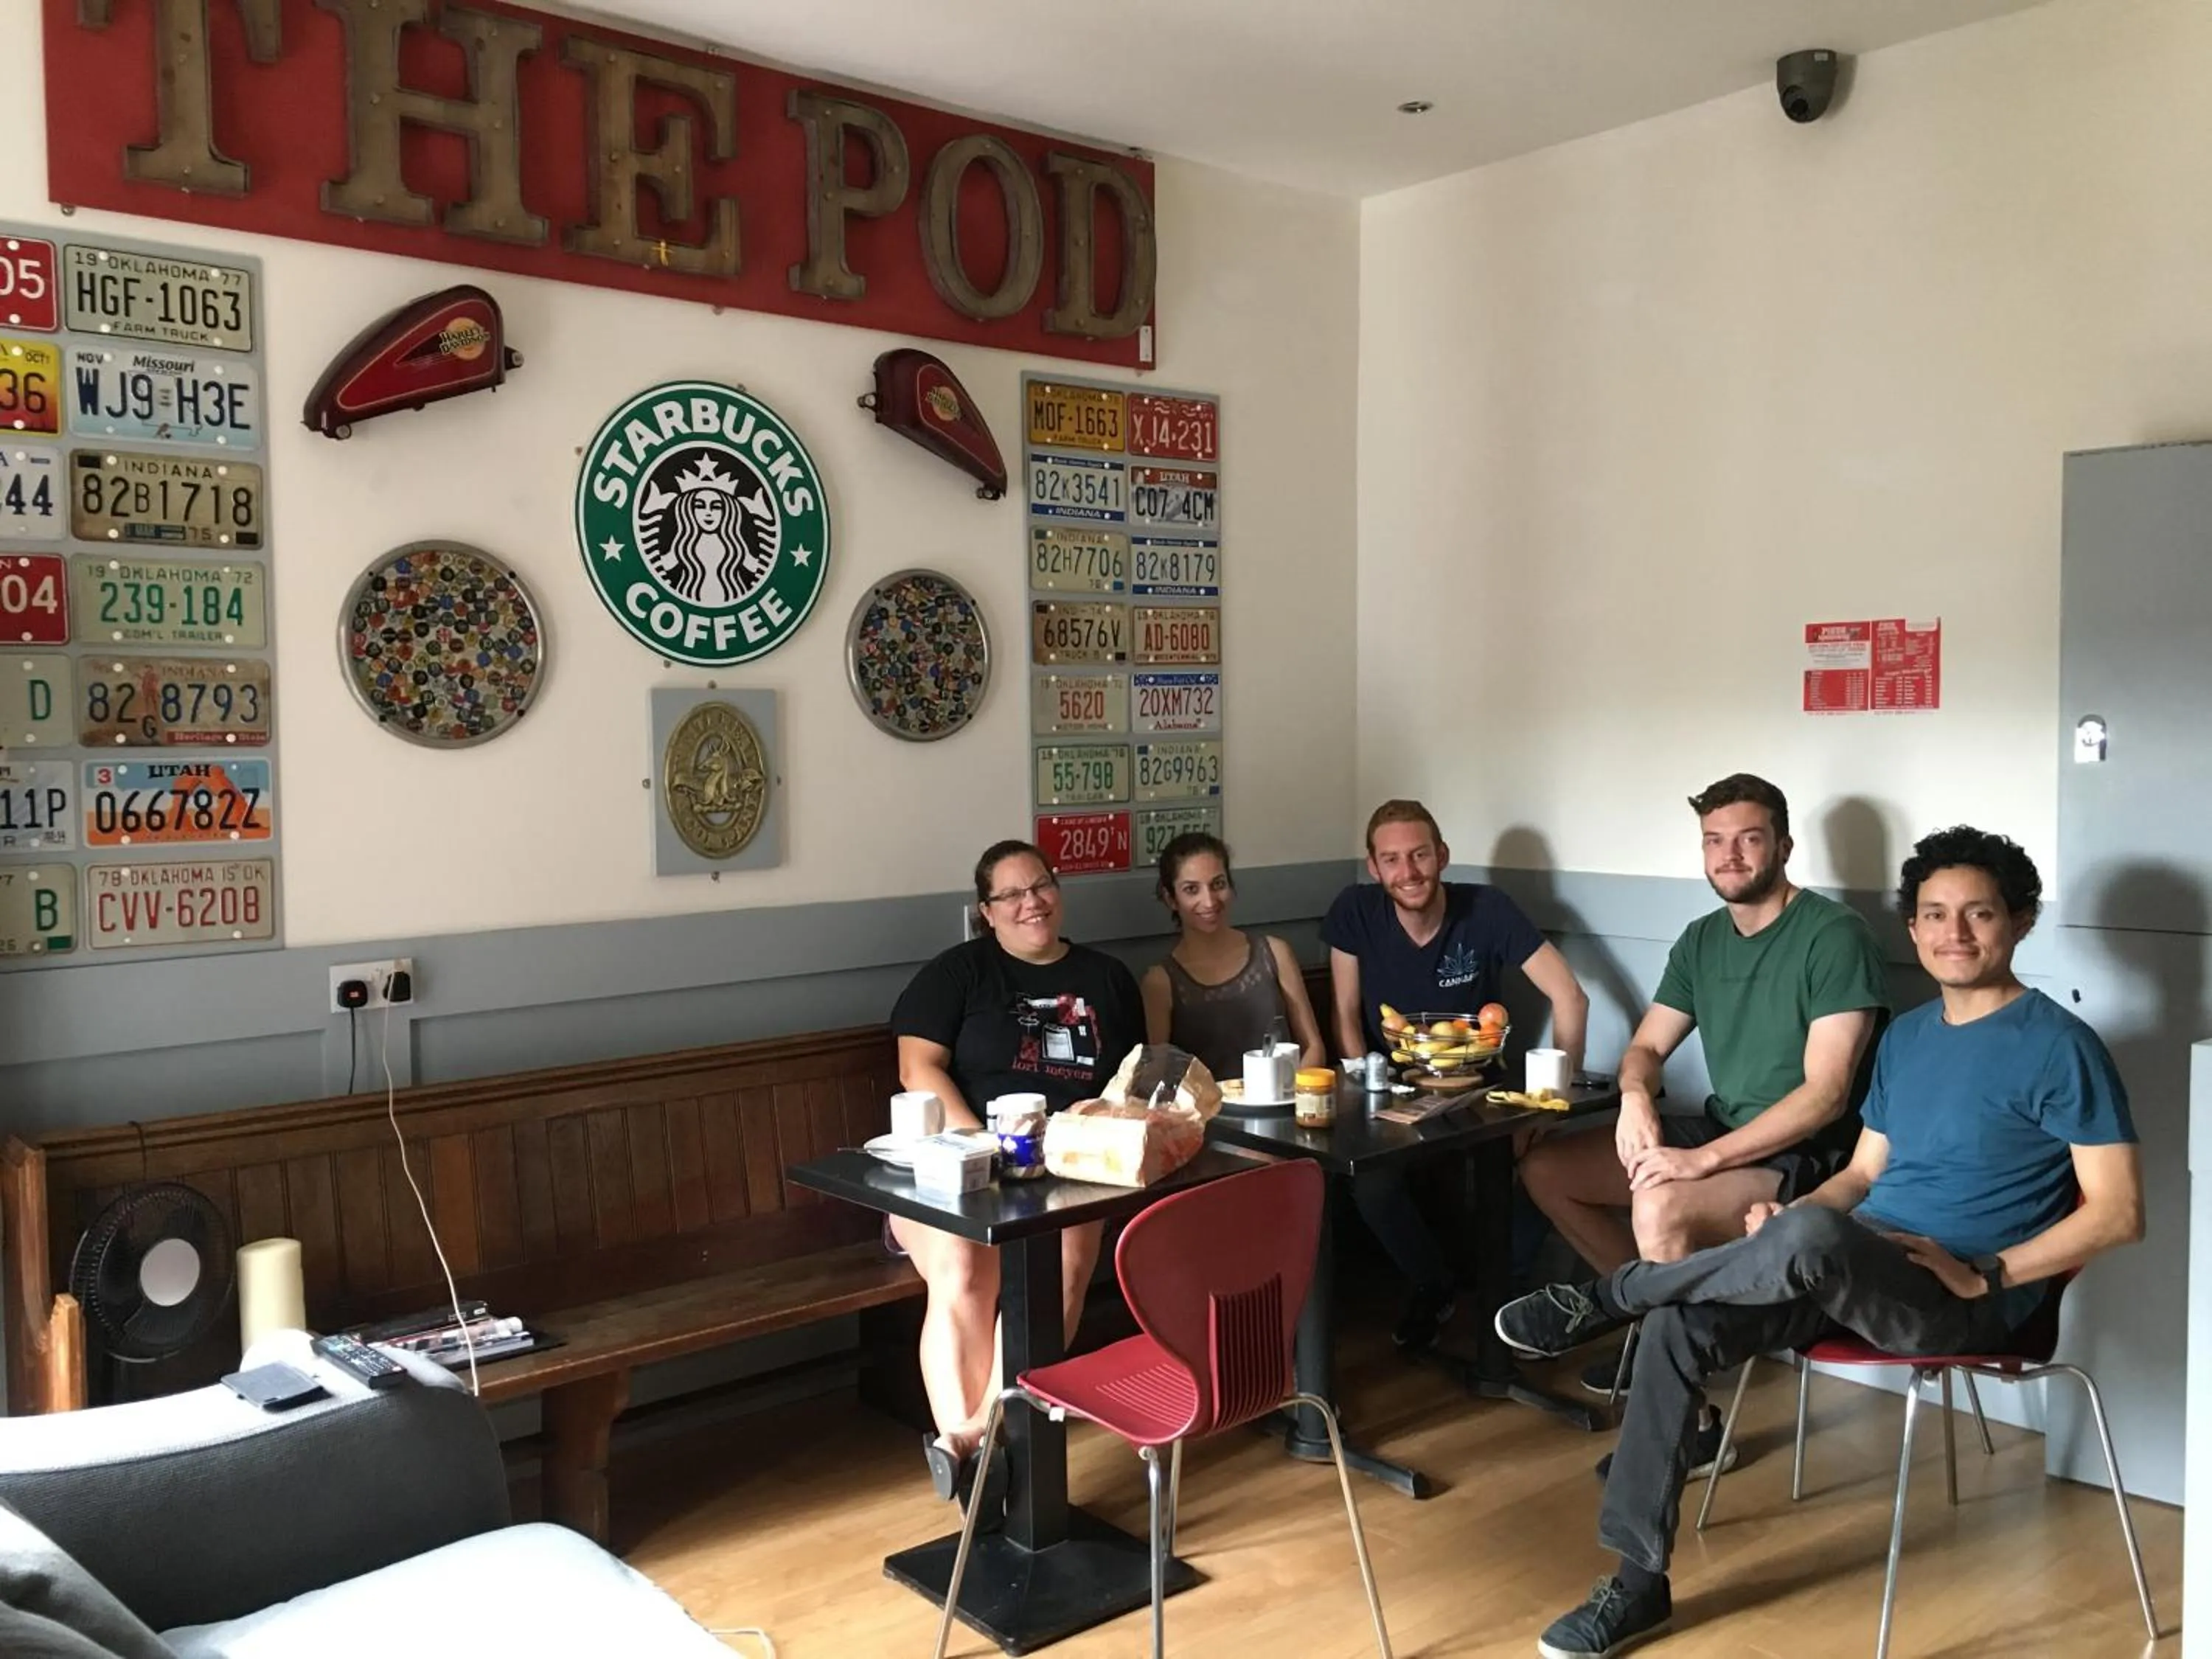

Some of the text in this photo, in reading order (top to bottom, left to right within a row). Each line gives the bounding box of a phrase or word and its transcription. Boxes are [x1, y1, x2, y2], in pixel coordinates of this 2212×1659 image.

[76, 0, 1156, 341] THE POD
[75, 251, 241, 285] 19 OKLAHOMA 77
[77, 271, 241, 331] HGF-1063
[112, 321, 209, 341] FARM TRUCK
[77, 352, 195, 372] NOV Missouri
[0, 369, 46, 414] 36
[125, 461, 212, 479] INDIANA
[594, 398, 813, 516] STARBUCKS
[5, 473, 53, 515] 44
[83, 473, 252, 526] 82B1718
[1057, 532, 1103, 545] INDIANA
[87, 566, 253, 584] 19 OKLAHOMA 72
[1036, 542, 1124, 578] 82H7706
[1, 574, 58, 614] 04
[100, 581, 243, 626] 239-184
[626, 582, 793, 650] COFFEE
[1043, 618, 1121, 649] 68576V
[1060, 690, 1105, 720] 5620
[1139, 686, 1214, 717] 20XM732
[97, 768, 111, 784] 3
[147, 764, 211, 779] UTAH
[0, 788, 66, 829] 11P
[96, 787, 260, 833] 066782Z
[131, 867, 214, 886] OKLAHOMA
[243, 866, 265, 880] OK
[35, 888, 58, 931] B
[98, 886, 260, 932] CVV-6208
